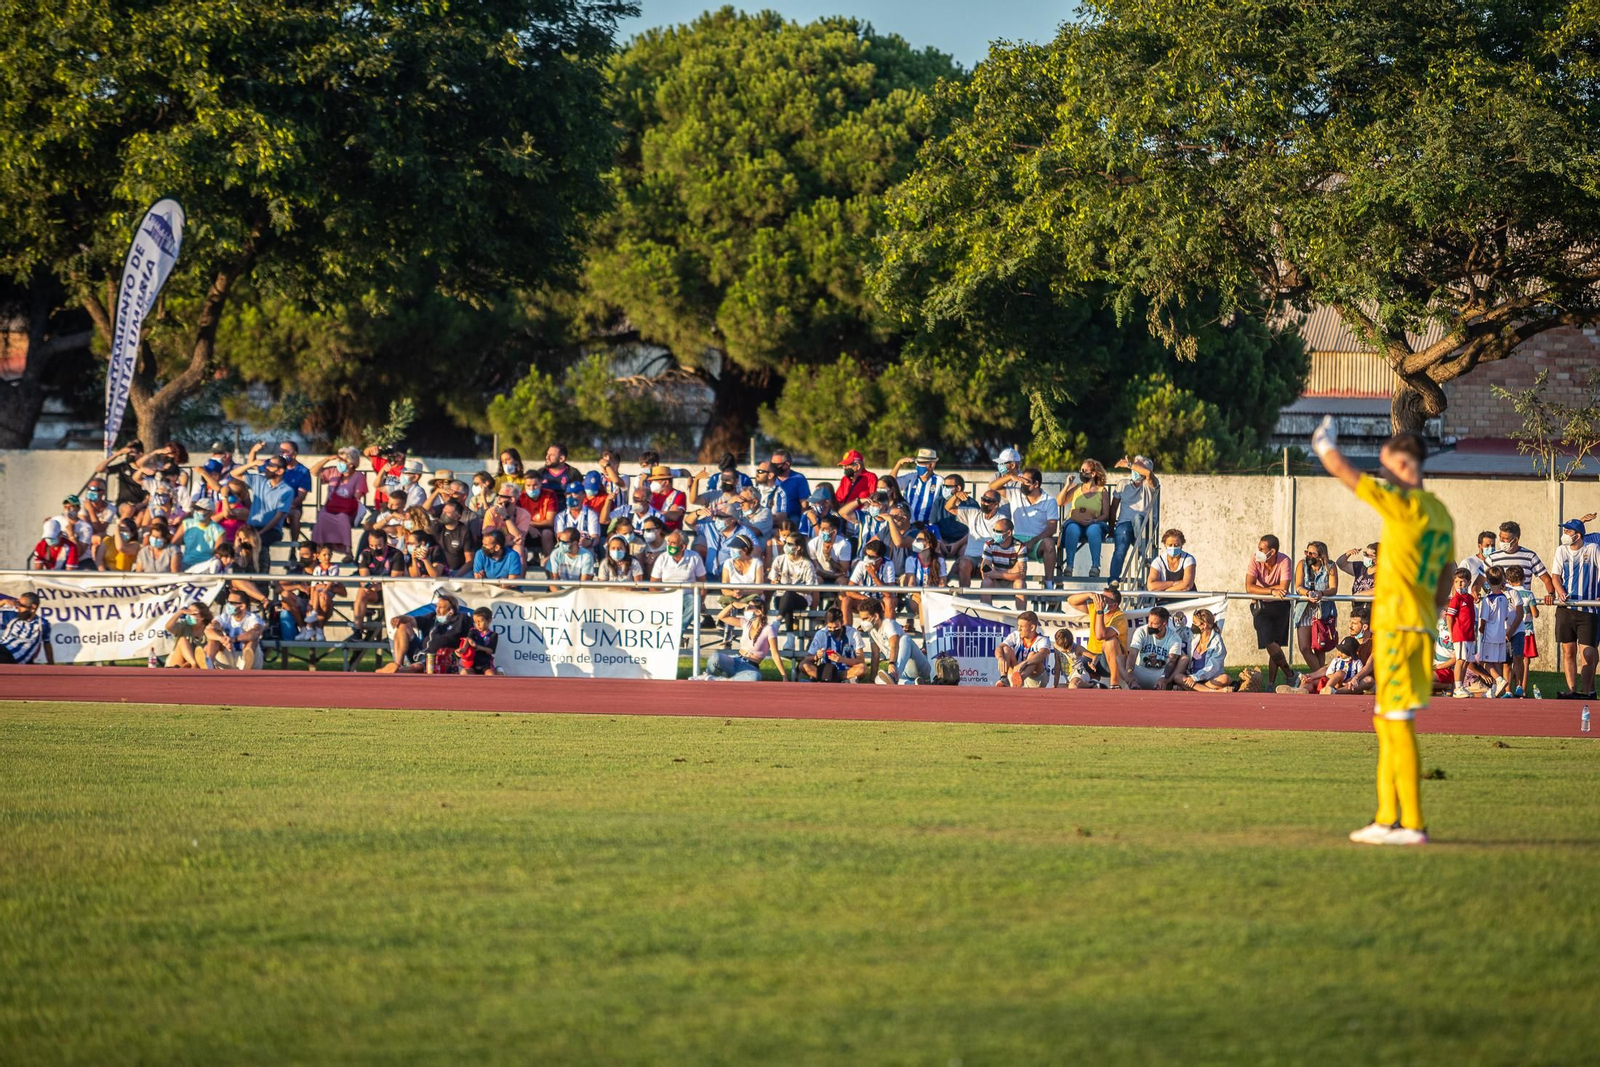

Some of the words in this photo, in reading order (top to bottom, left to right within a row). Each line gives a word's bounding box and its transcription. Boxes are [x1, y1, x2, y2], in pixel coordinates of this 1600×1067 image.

[130, 243, 146, 270] DE
[36, 583, 180, 601] AYUNTAMIEN
[183, 582, 208, 602] DE
[41, 604, 122, 622] PUNTA
[493, 604, 645, 625] AYUNTAMIENTO
[650, 610, 674, 626] DE
[55, 629, 125, 646] Concejalía
[129, 630, 144, 642] de
[493, 624, 573, 647] PUNTA
[580, 625, 675, 650] UMBRÍA
[514, 650, 573, 664] Delegación
[577, 653, 591, 664] de
[594, 653, 647, 665] Deportes
